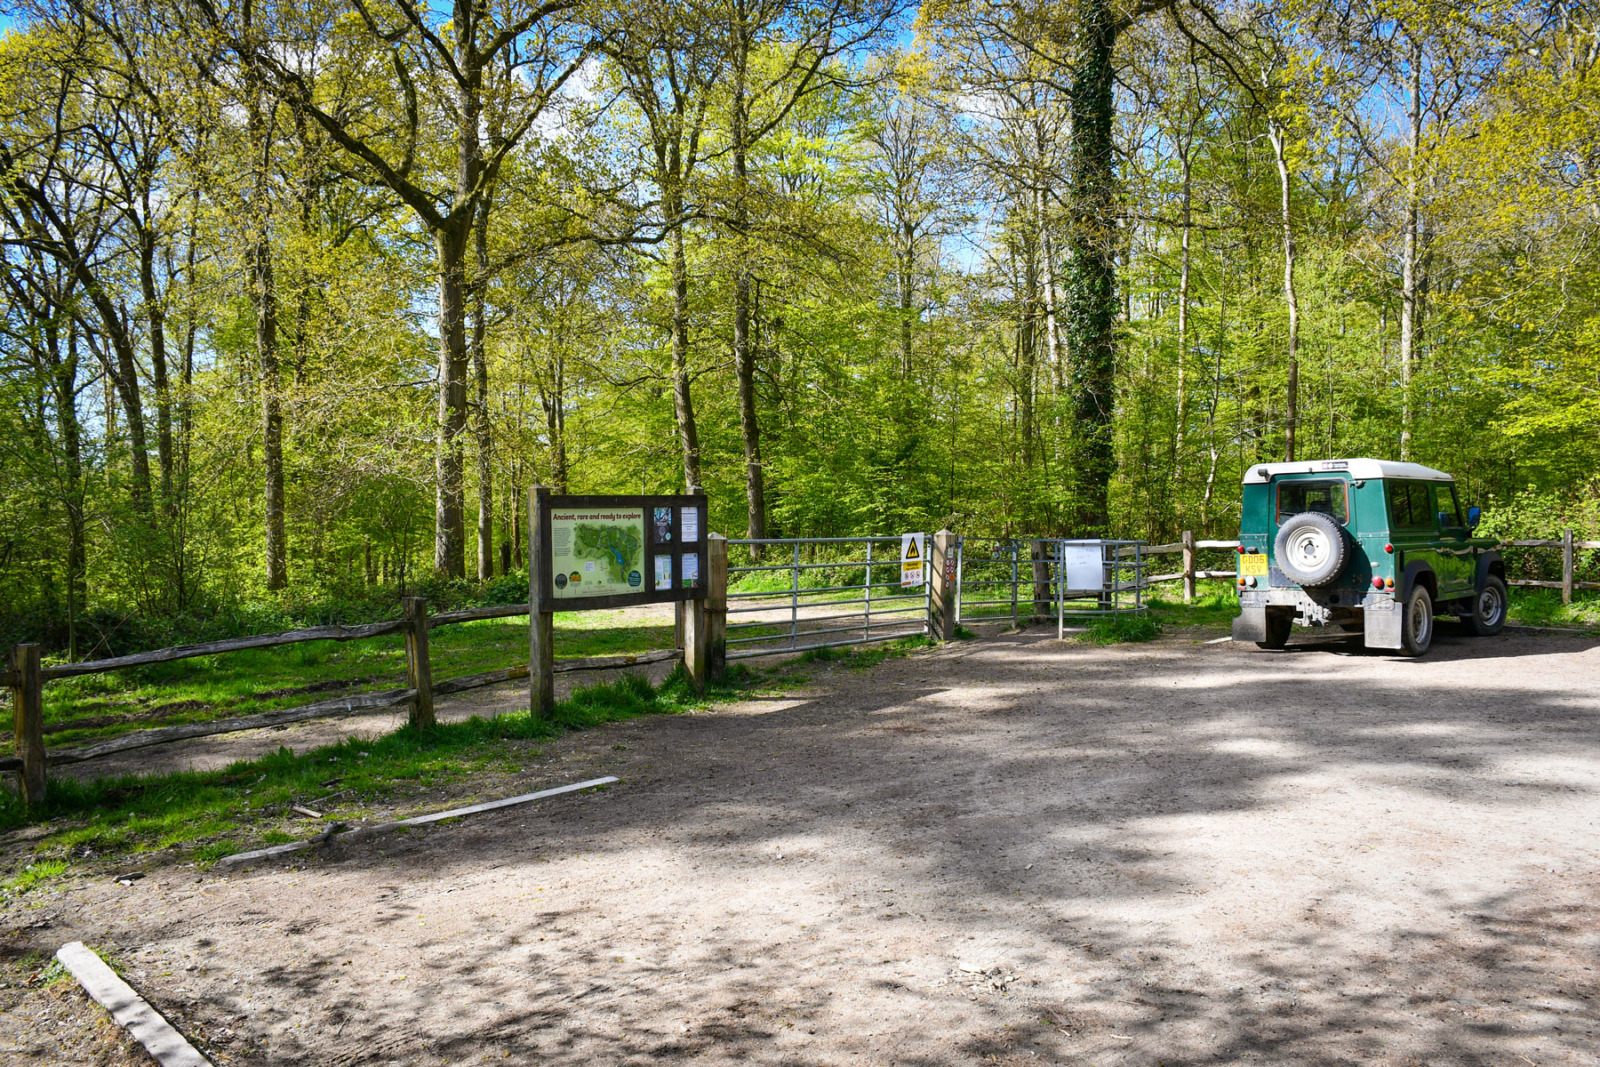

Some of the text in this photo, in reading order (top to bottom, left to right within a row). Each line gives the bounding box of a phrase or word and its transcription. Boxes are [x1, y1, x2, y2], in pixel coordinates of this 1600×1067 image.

[553, 513, 576, 521] Ancient,
[600, 513, 616, 522] ready
[622, 512, 641, 521] explore
[1245, 565, 1262, 574] KSV
